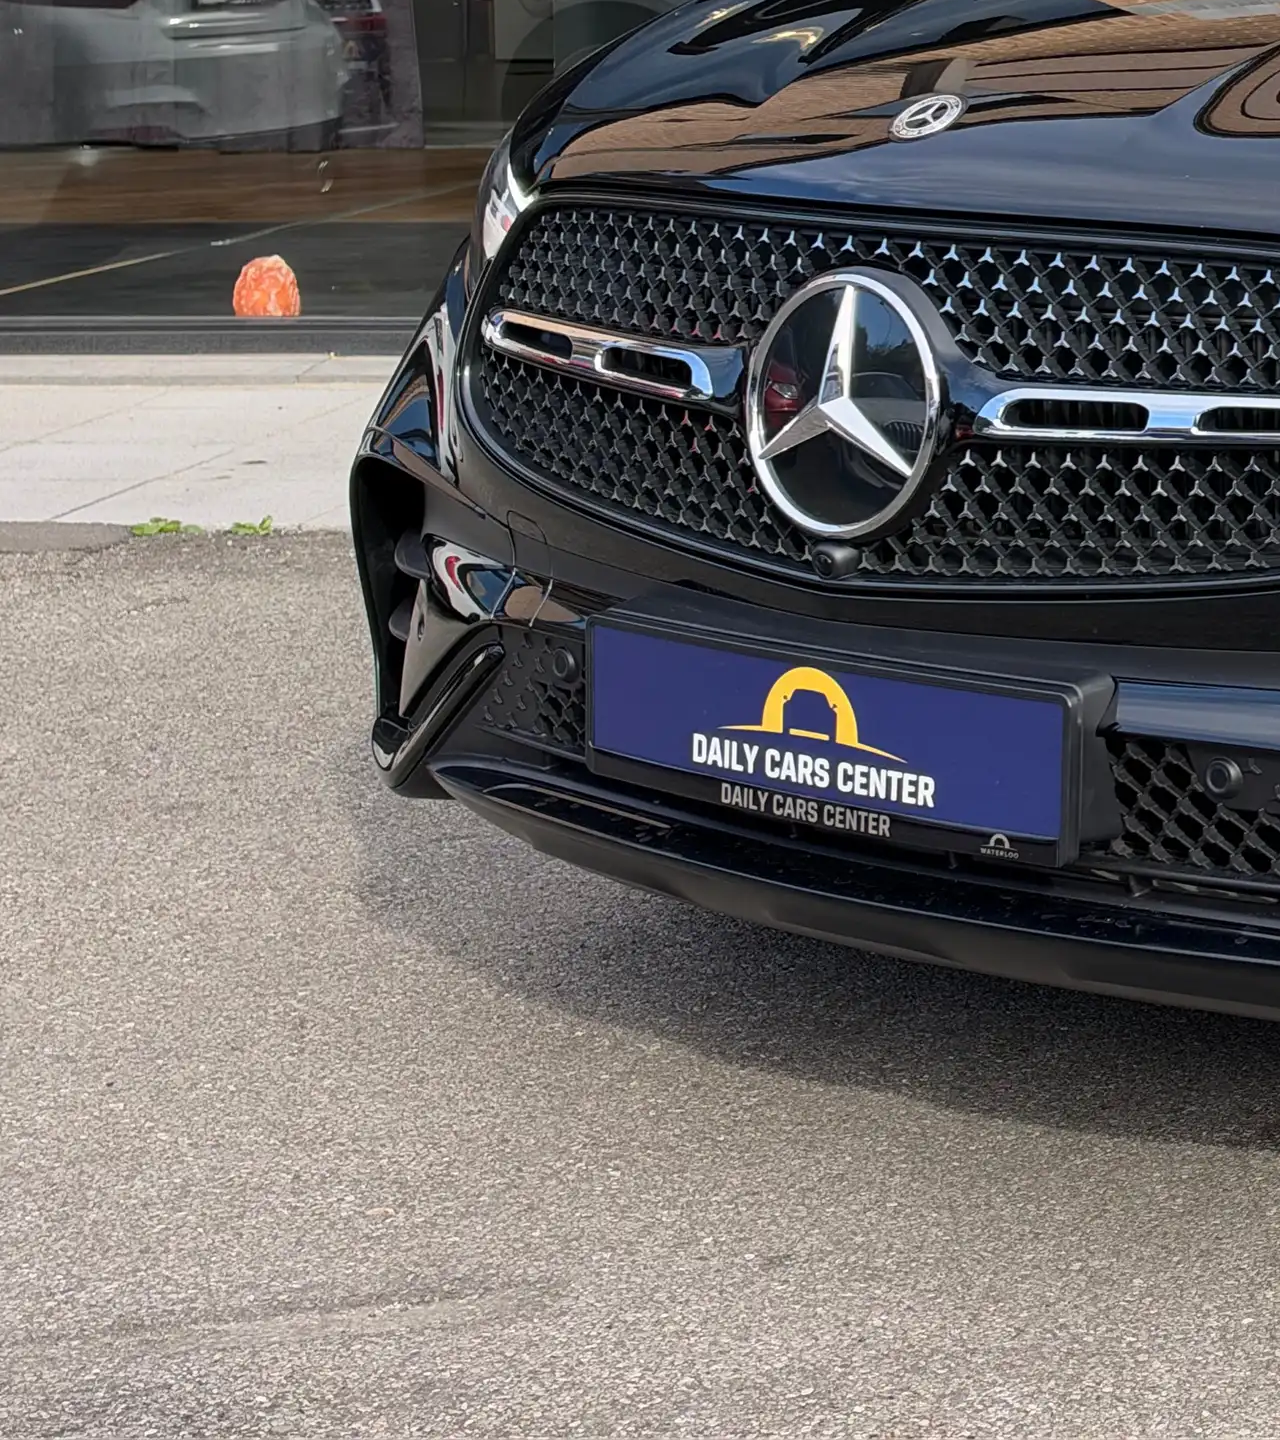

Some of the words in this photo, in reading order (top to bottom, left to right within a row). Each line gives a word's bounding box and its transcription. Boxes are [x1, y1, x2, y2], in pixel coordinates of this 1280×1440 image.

[692, 733, 760, 774] DAILY
[764, 746, 831, 788] CARS
[836, 761, 936, 808] CENTER
[720, 782, 769, 812] DAILY
[772, 793, 819, 823] CARS
[823, 805, 892, 838] CENTER
[979, 847, 1020, 859] WATERLOO
